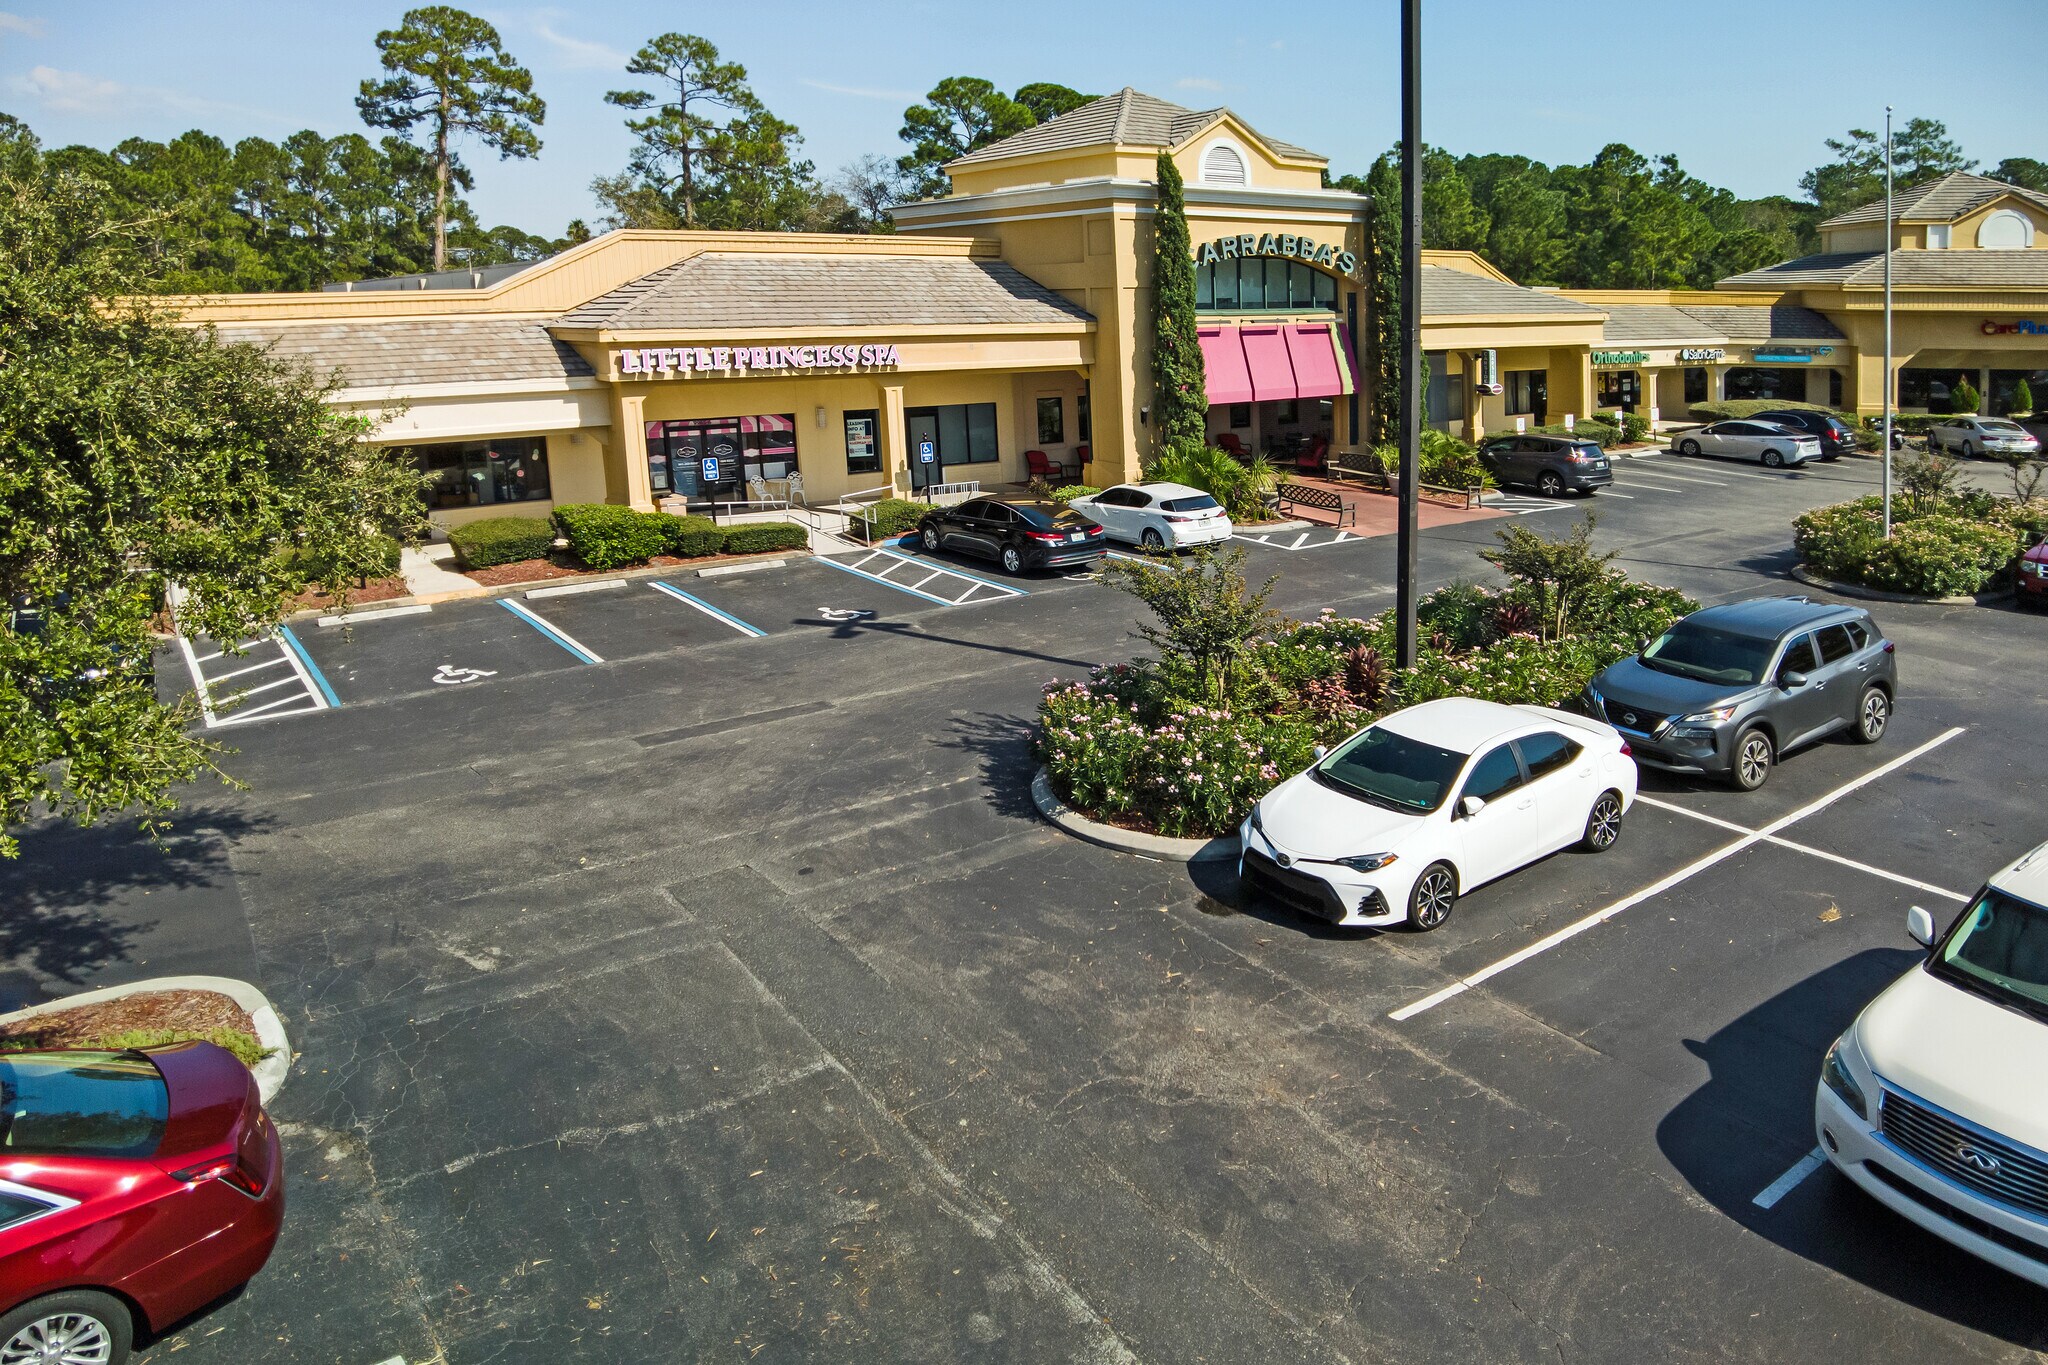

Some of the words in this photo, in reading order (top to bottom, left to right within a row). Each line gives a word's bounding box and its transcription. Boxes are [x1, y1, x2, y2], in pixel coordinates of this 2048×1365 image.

[620, 346, 731, 373] LITTLE
[732, 344, 859, 370] PRINCESS
[860, 344, 901, 366] SPA
[1592, 350, 1651, 364] Orthodontics
